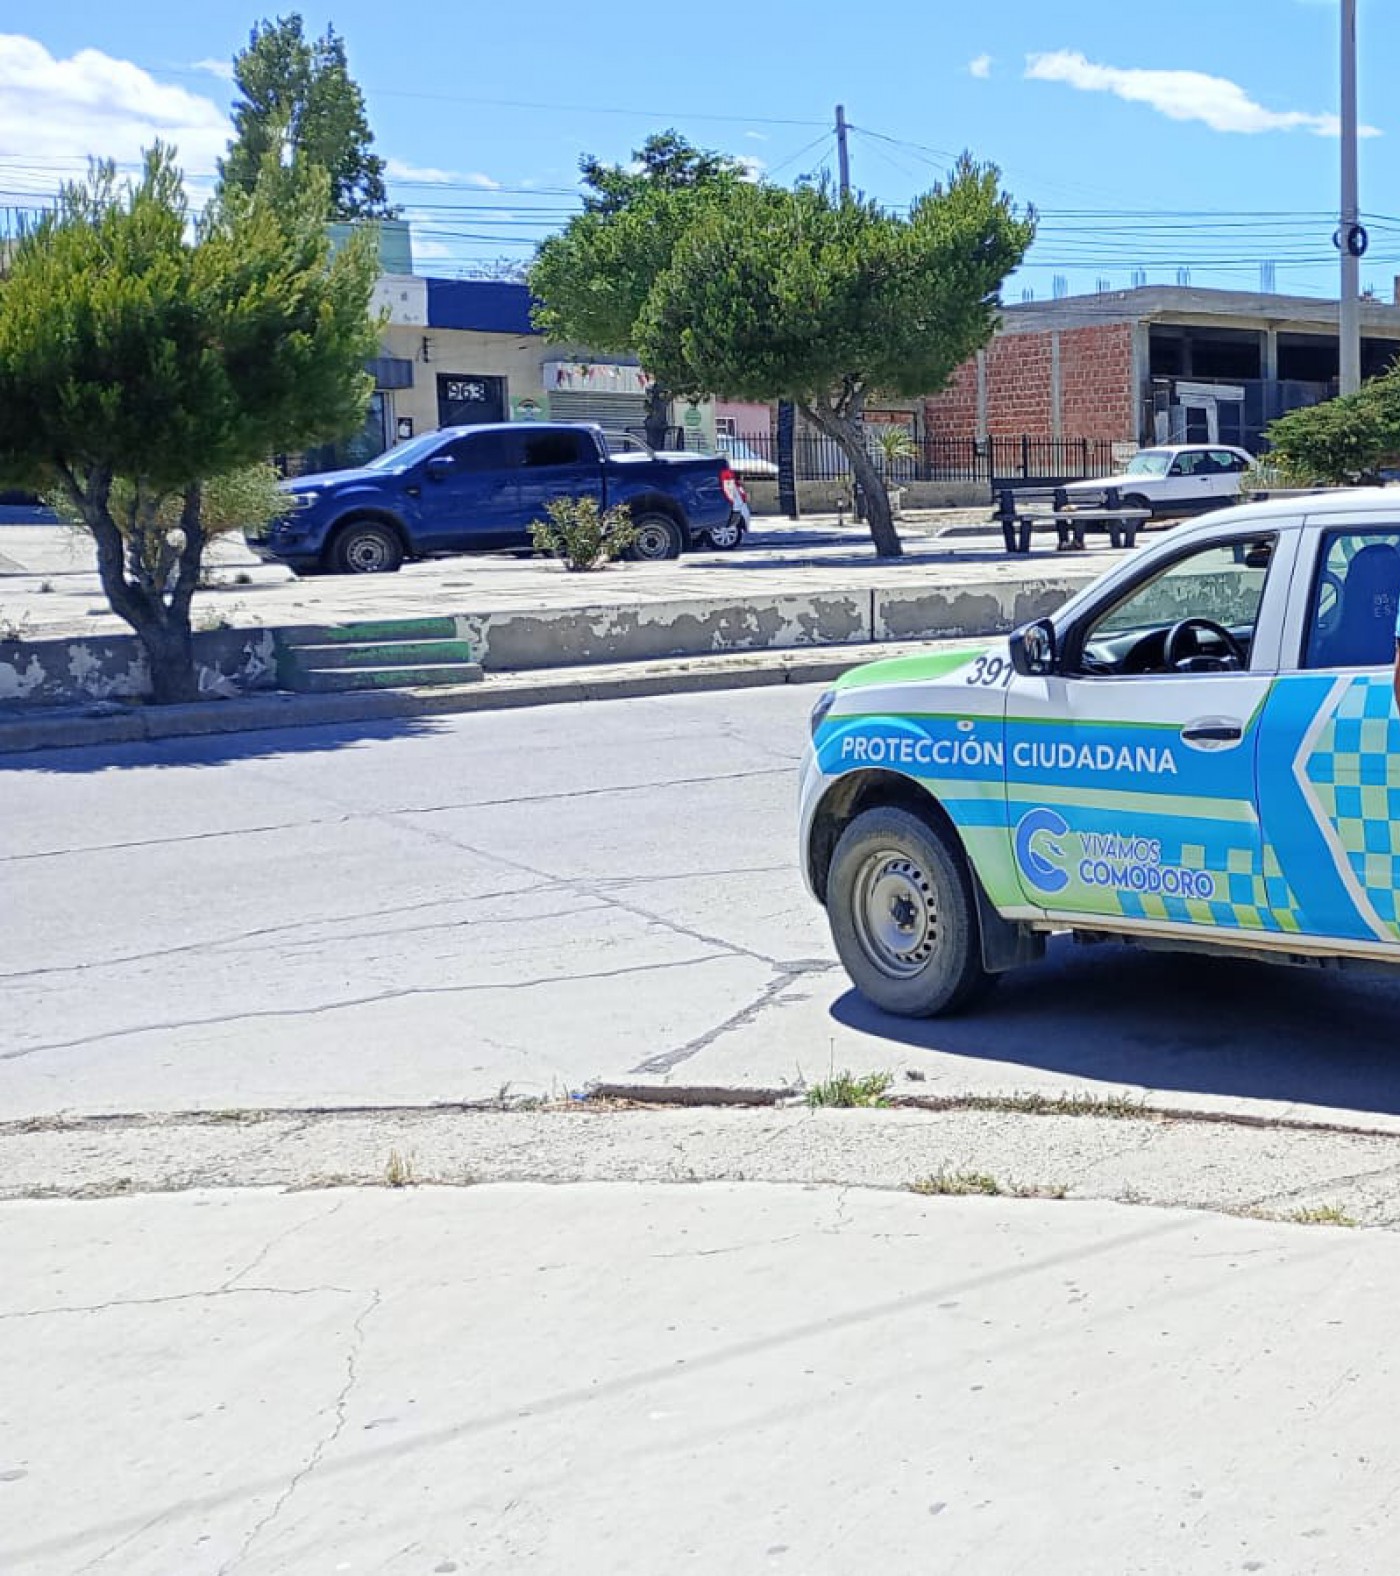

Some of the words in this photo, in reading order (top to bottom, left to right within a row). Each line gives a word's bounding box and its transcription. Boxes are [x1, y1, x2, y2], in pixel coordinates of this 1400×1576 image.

[967, 656, 1014, 687] 391
[841, 736, 1003, 766] PROTECCIÓN
[1013, 743, 1177, 775] CIUDADANA
[1079, 833, 1160, 864] VIVAMOS
[1079, 859, 1215, 898] COMODORO
